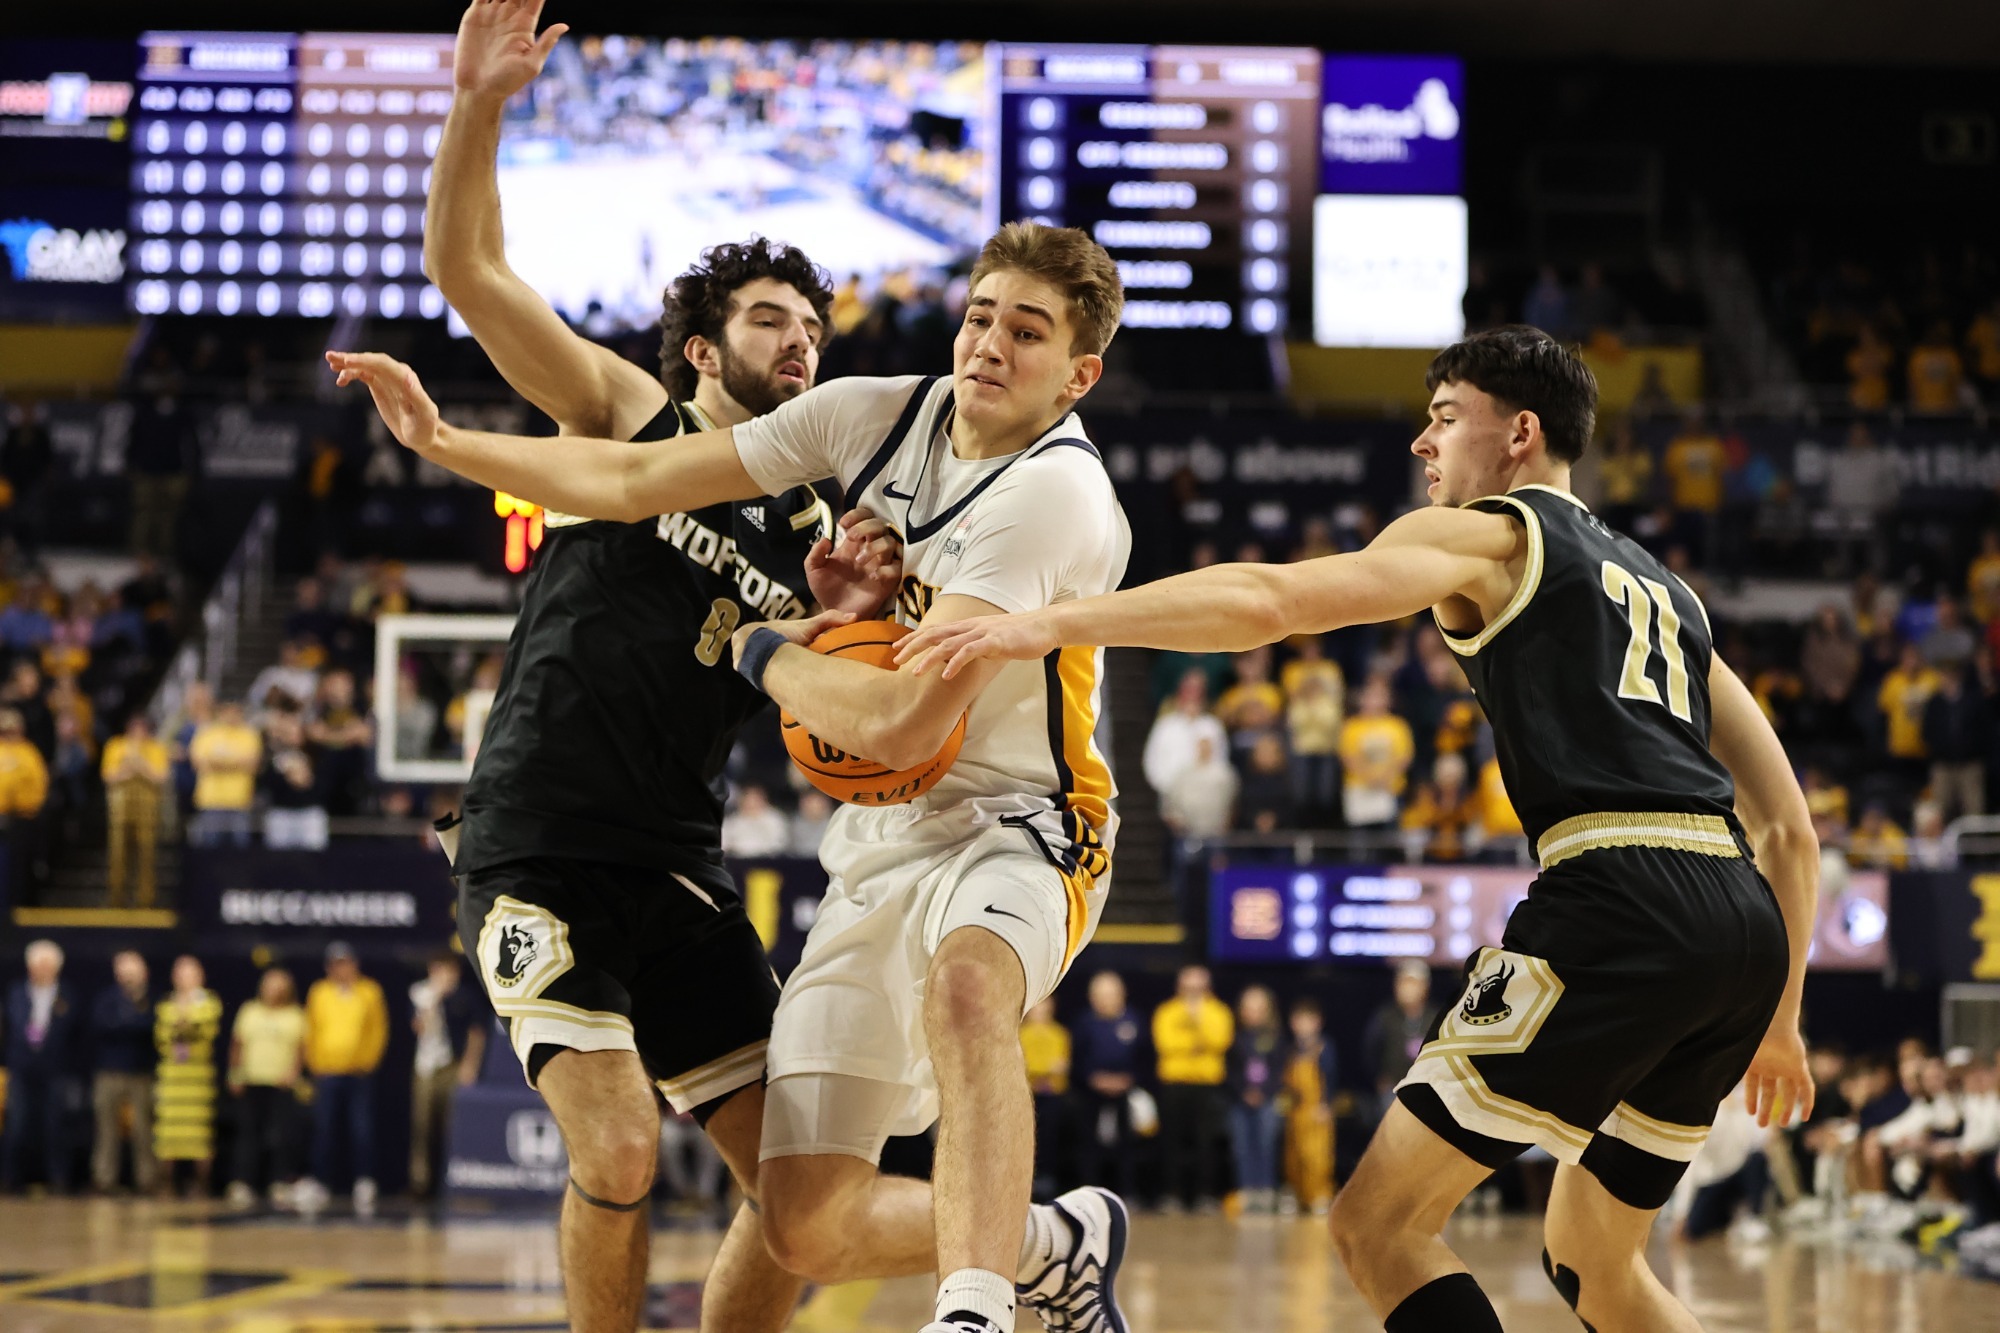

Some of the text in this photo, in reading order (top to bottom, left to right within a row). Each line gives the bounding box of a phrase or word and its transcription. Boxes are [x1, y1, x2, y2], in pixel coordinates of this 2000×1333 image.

[741, 508, 766, 533] adidas
[655, 511, 807, 622] WOFFORD
[694, 597, 741, 668] 0
[1601, 560, 1693, 724] 21
[851, 777, 922, 804] EVO
[220, 890, 417, 927] BUCCANEER
